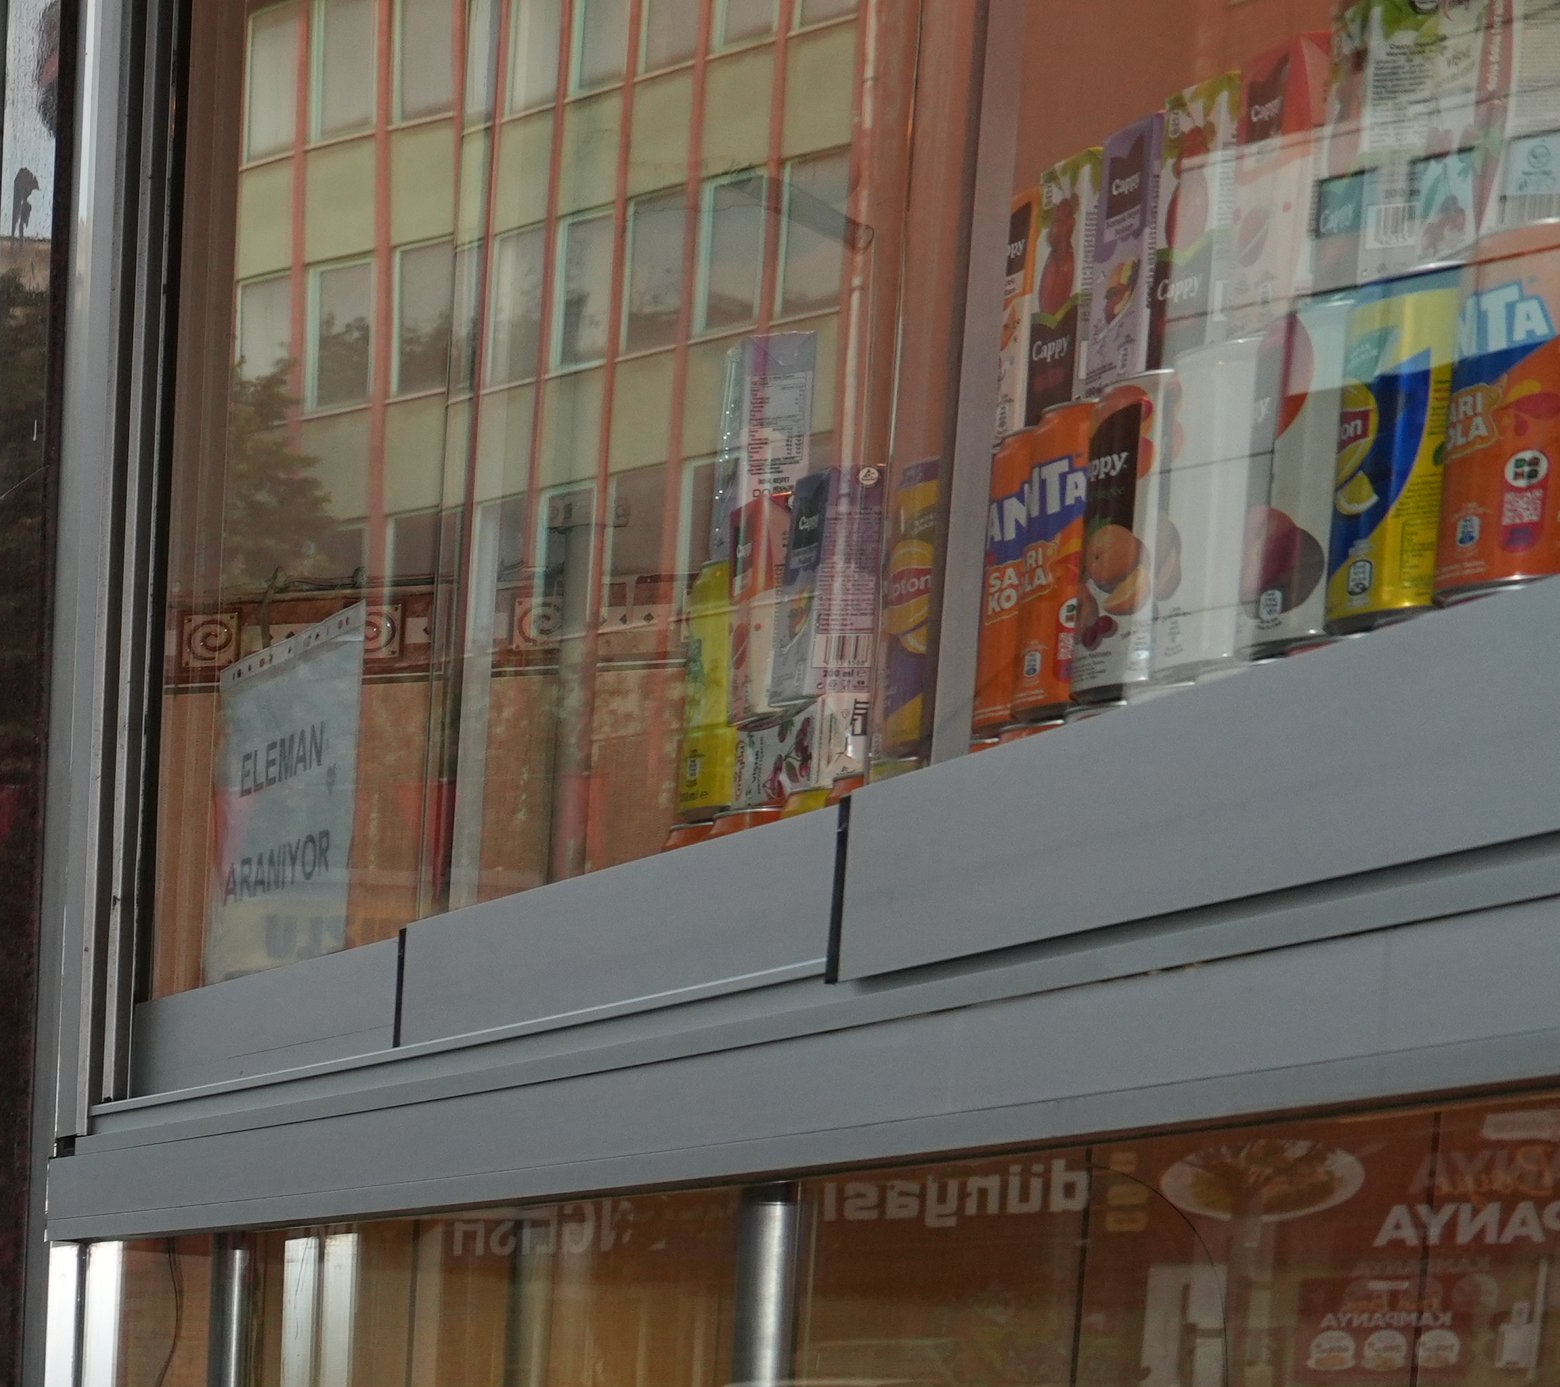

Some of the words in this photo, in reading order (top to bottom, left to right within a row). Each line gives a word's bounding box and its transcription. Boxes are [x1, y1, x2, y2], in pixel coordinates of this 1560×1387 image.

[1157, 272, 1203, 301] Cappy
[1031, 334, 1070, 362] Cappy
[1087, 451, 1129, 482] ppy
[239, 719, 325, 799] ELEMAN
[223, 830, 331, 907] ARANIYOR
